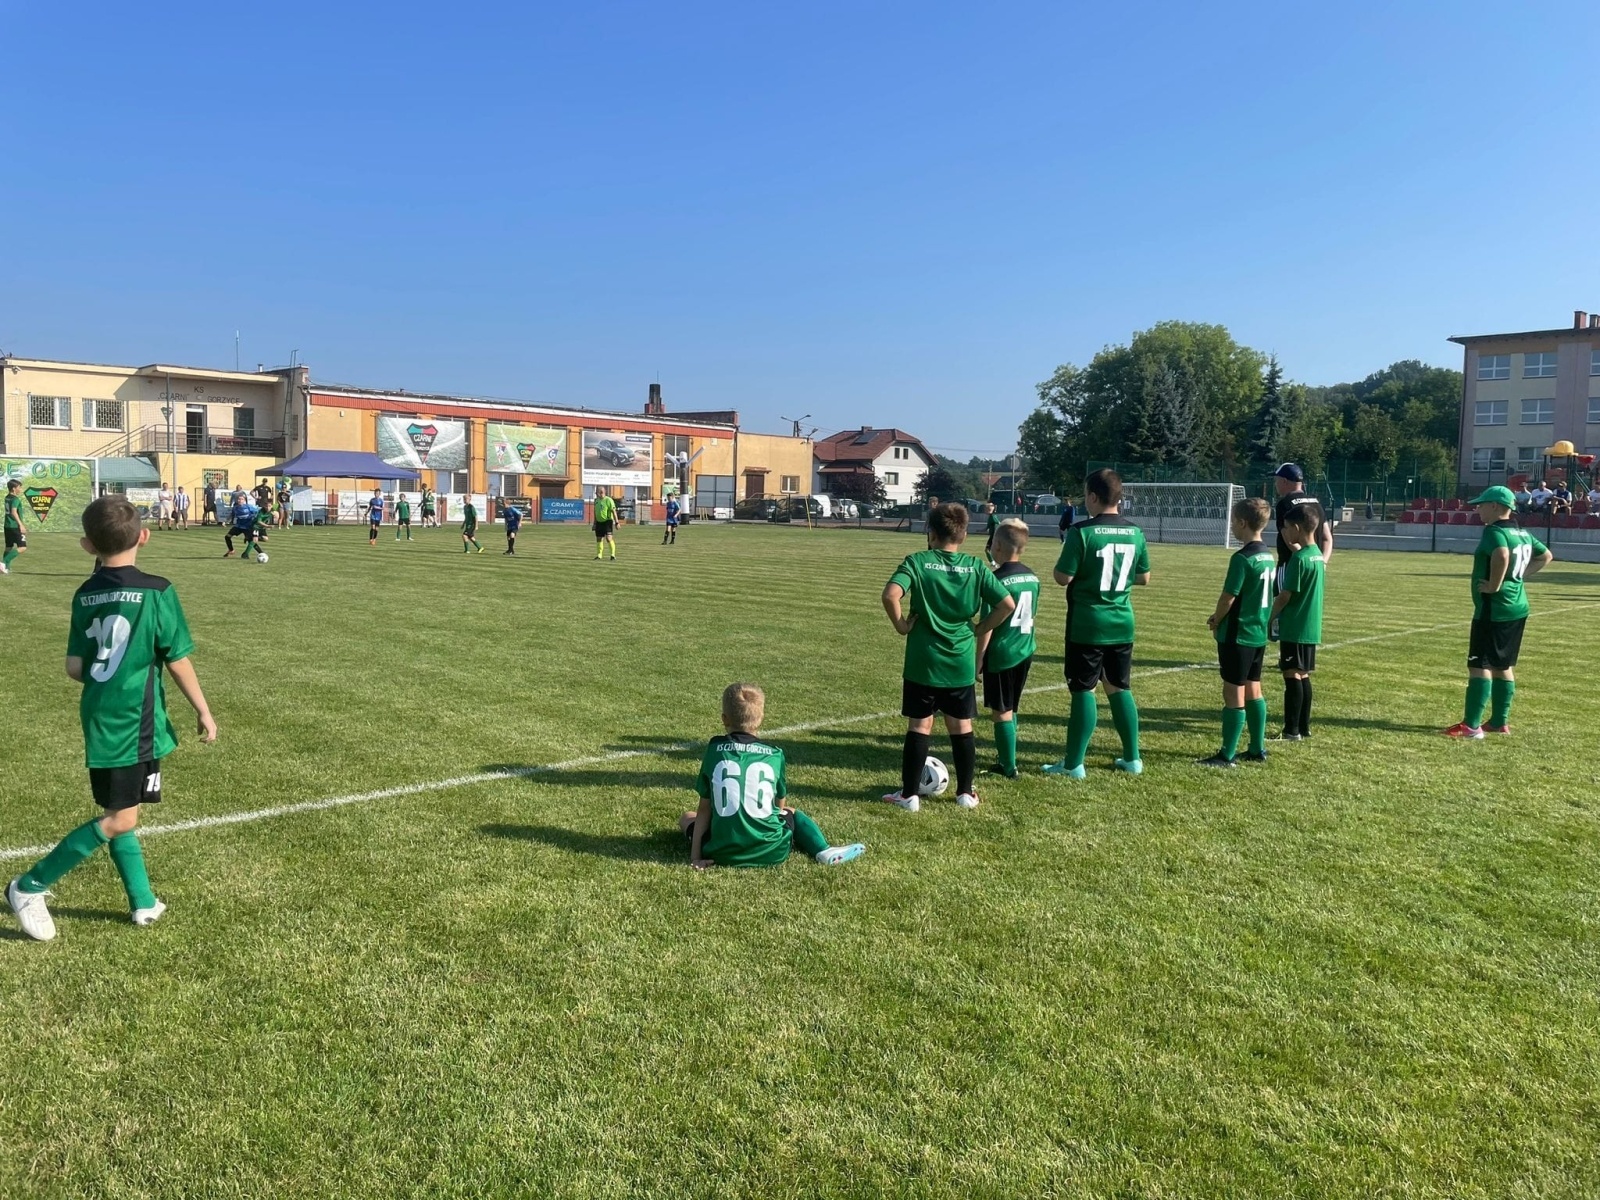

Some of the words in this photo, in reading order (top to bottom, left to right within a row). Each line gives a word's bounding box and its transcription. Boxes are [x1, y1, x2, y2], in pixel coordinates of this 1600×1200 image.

[193, 386, 204, 394] KS
[207, 395, 241, 405] GORZYCE
[32, 462, 81, 479] CUP
[1096, 543, 1136, 591] 17
[1010, 590, 1034, 635] 4
[85, 615, 131, 683] 19
[711, 759, 775, 819] 66
